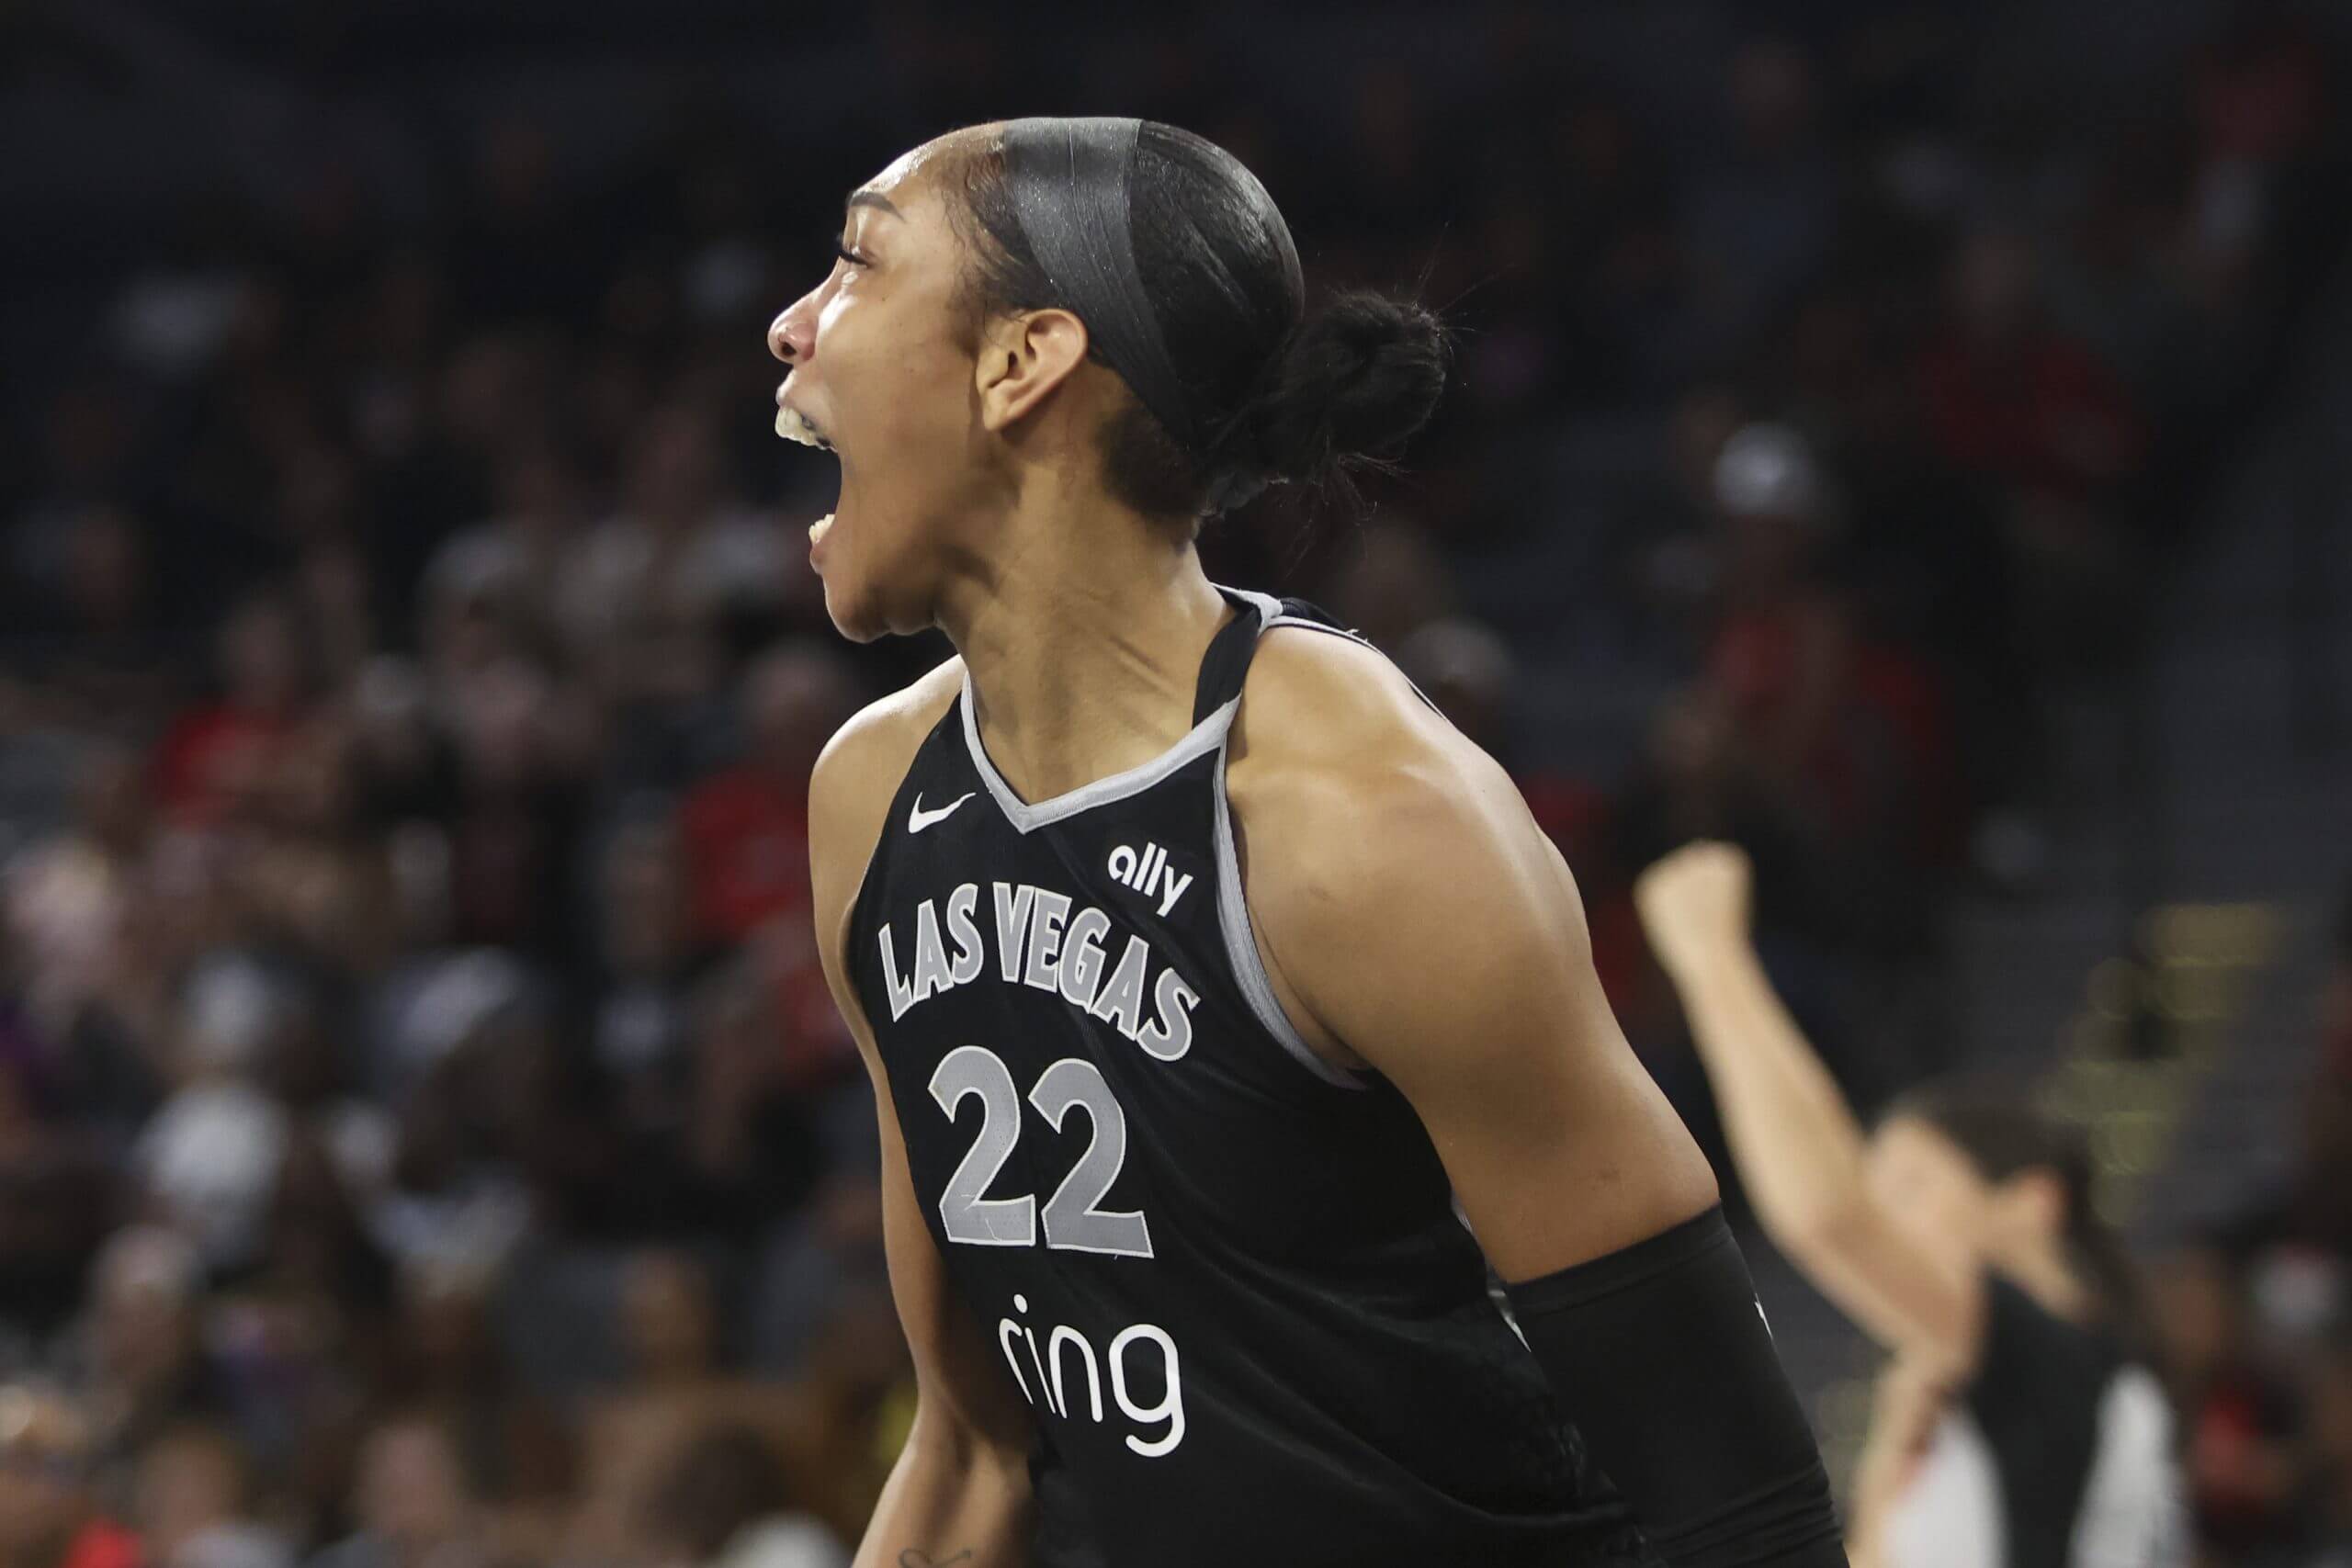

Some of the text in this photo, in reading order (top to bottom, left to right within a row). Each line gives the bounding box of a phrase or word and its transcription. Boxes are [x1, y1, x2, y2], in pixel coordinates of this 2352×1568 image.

[1108, 841, 1193, 917] ally
[878, 881, 1202, 1062] LAS VEGAS
[927, 1044, 1154, 1258] 22
[999, 1293, 1186, 1458] ring
